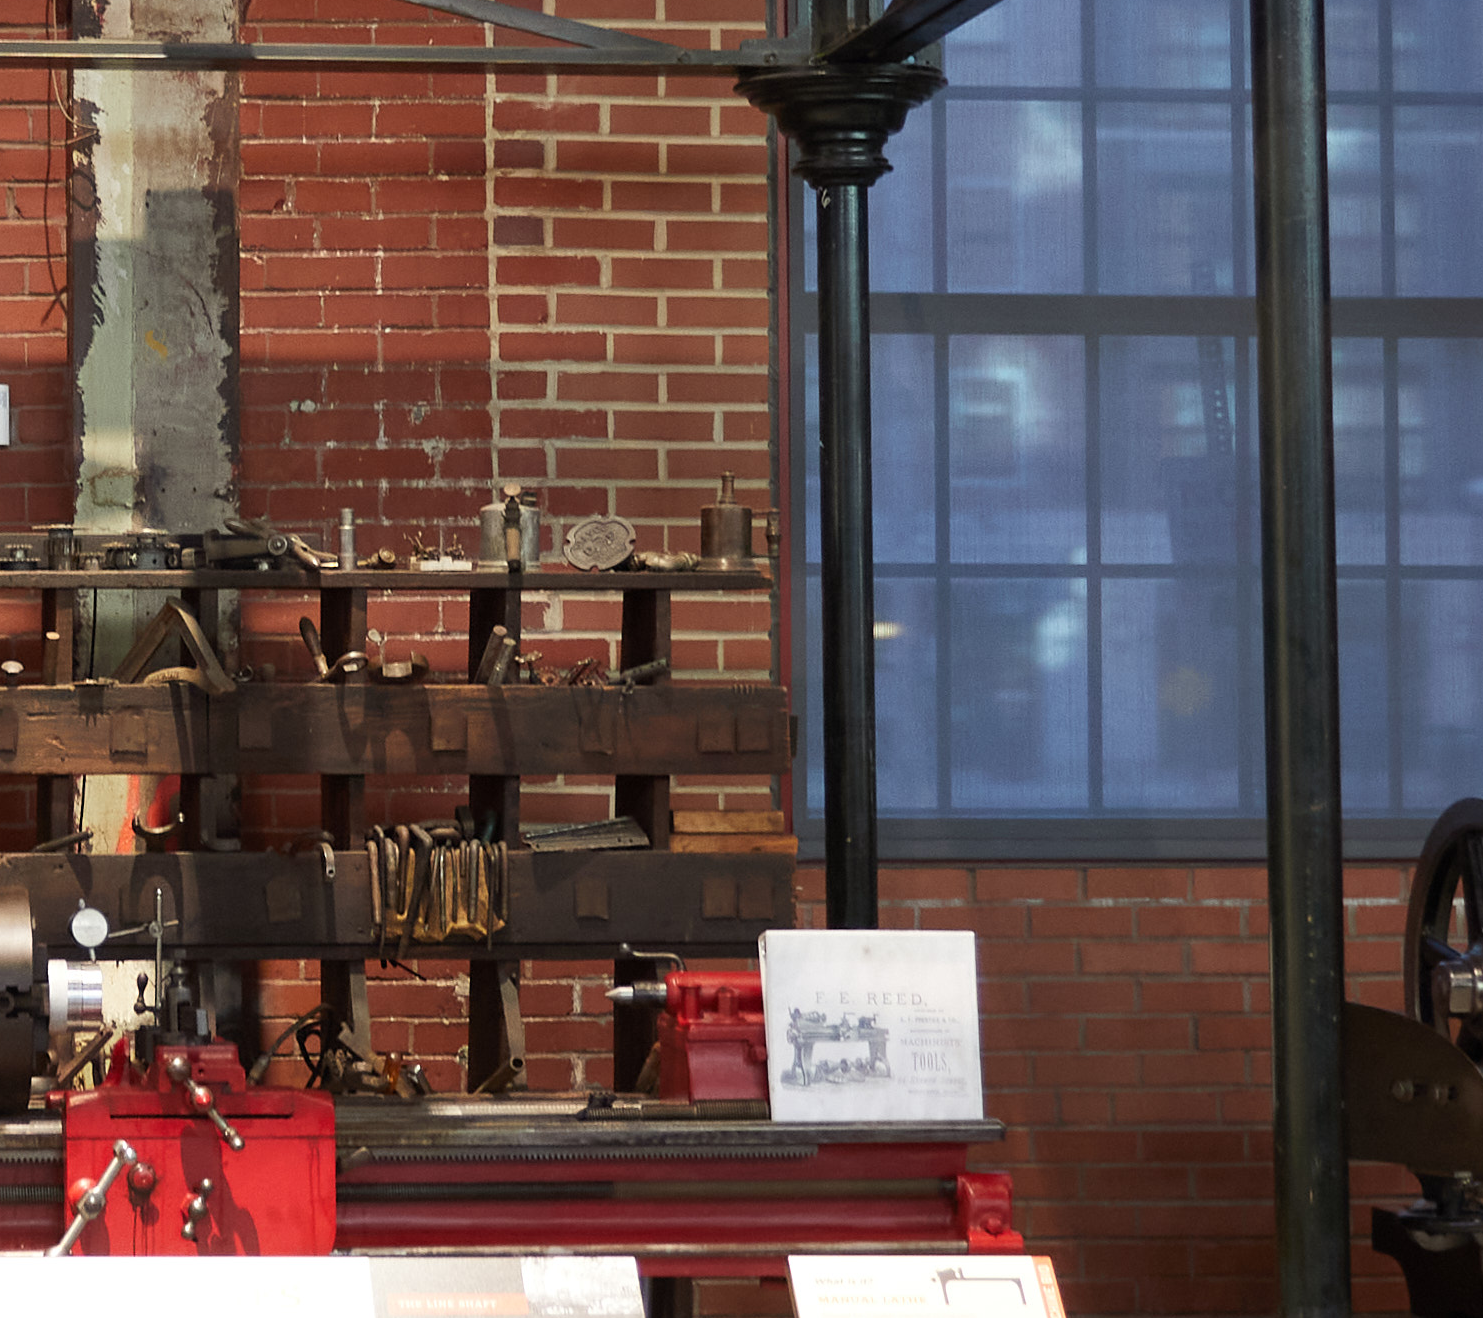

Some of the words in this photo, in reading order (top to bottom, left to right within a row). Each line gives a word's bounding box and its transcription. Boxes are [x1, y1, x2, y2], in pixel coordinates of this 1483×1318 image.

[867, 992, 928, 1007] REED,
[911, 1051, 951, 1074] TOOLS,
[398, 1299, 421, 1309] THE
[426, 1299, 454, 1309] LINE
[458, 1299, 497, 1309] SHAFT
[818, 1295, 878, 1305] MANUAL
[882, 1295, 928, 1305] LATHE
